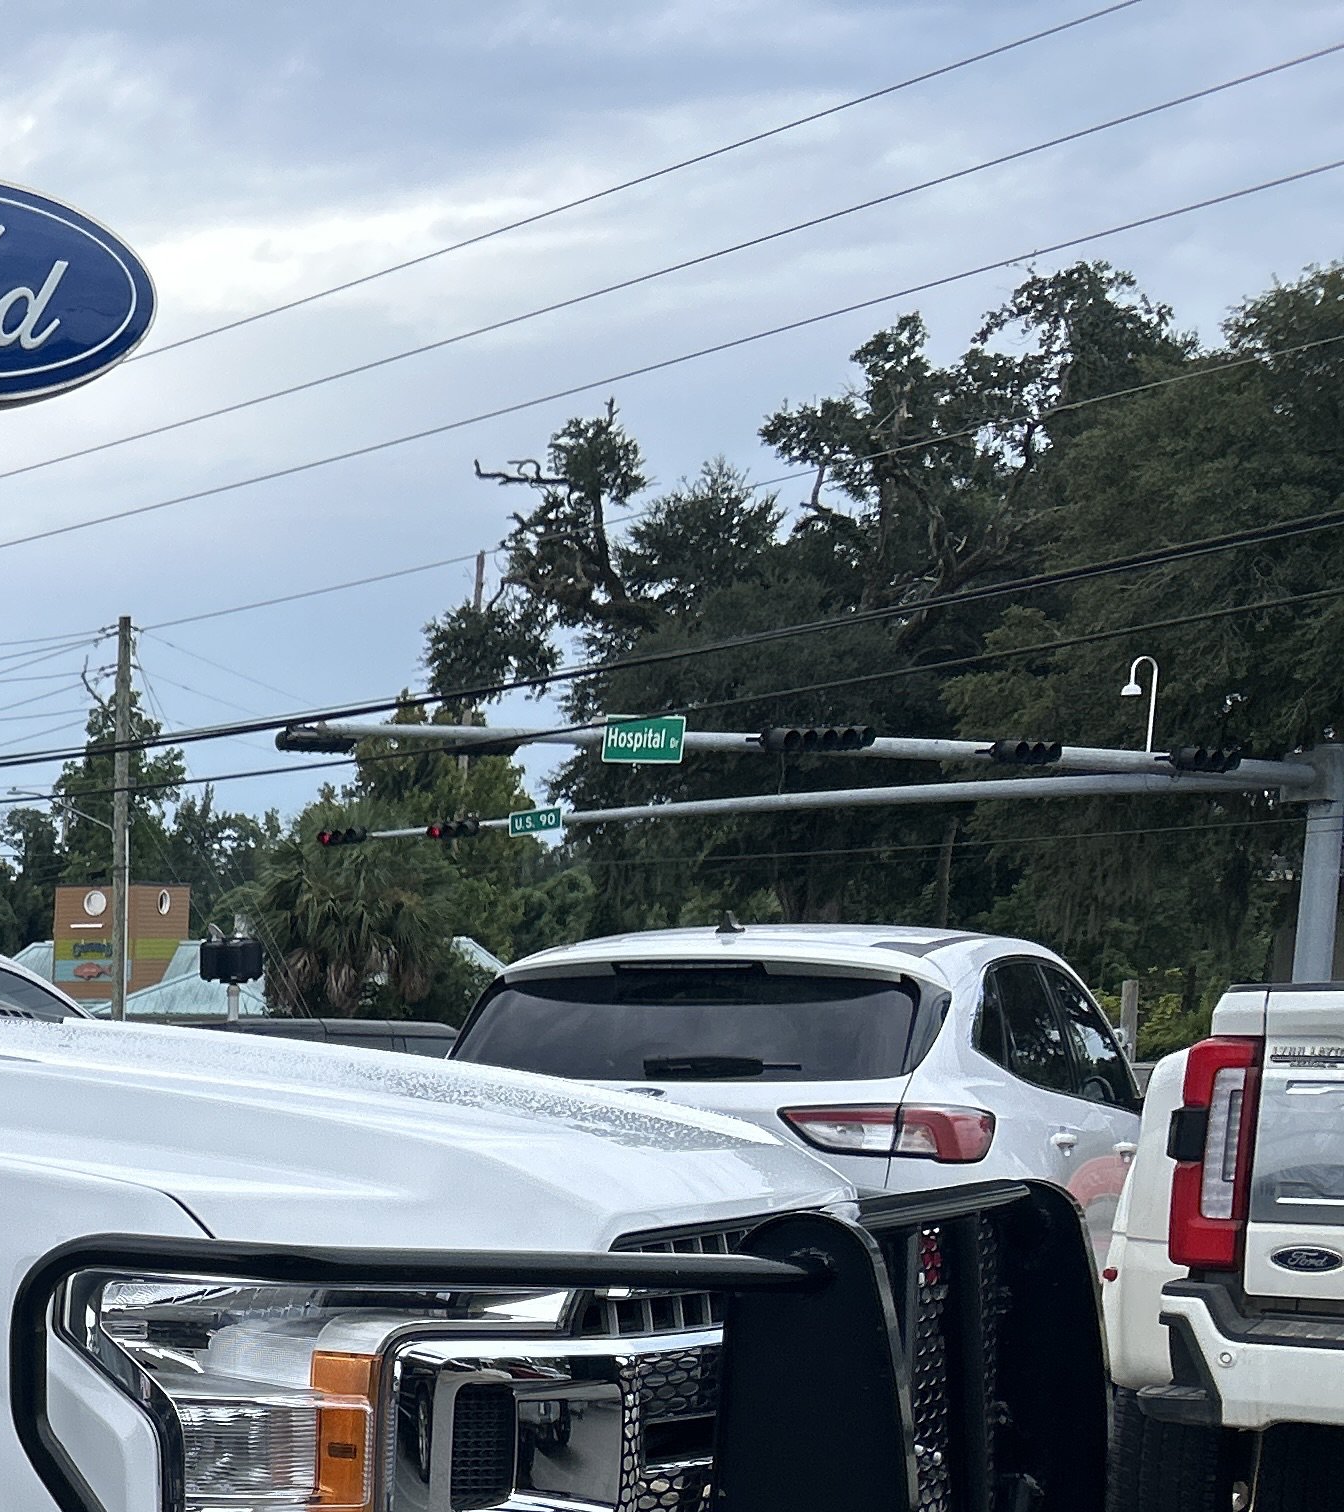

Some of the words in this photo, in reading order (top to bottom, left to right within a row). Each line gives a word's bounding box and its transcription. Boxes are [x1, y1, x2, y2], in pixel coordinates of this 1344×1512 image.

[607, 727, 667, 753] Hospital
[515, 816, 535, 831] U.S.
[539, 812, 556, 827] 90
[1287, 1250, 1329, 1267] Ford
